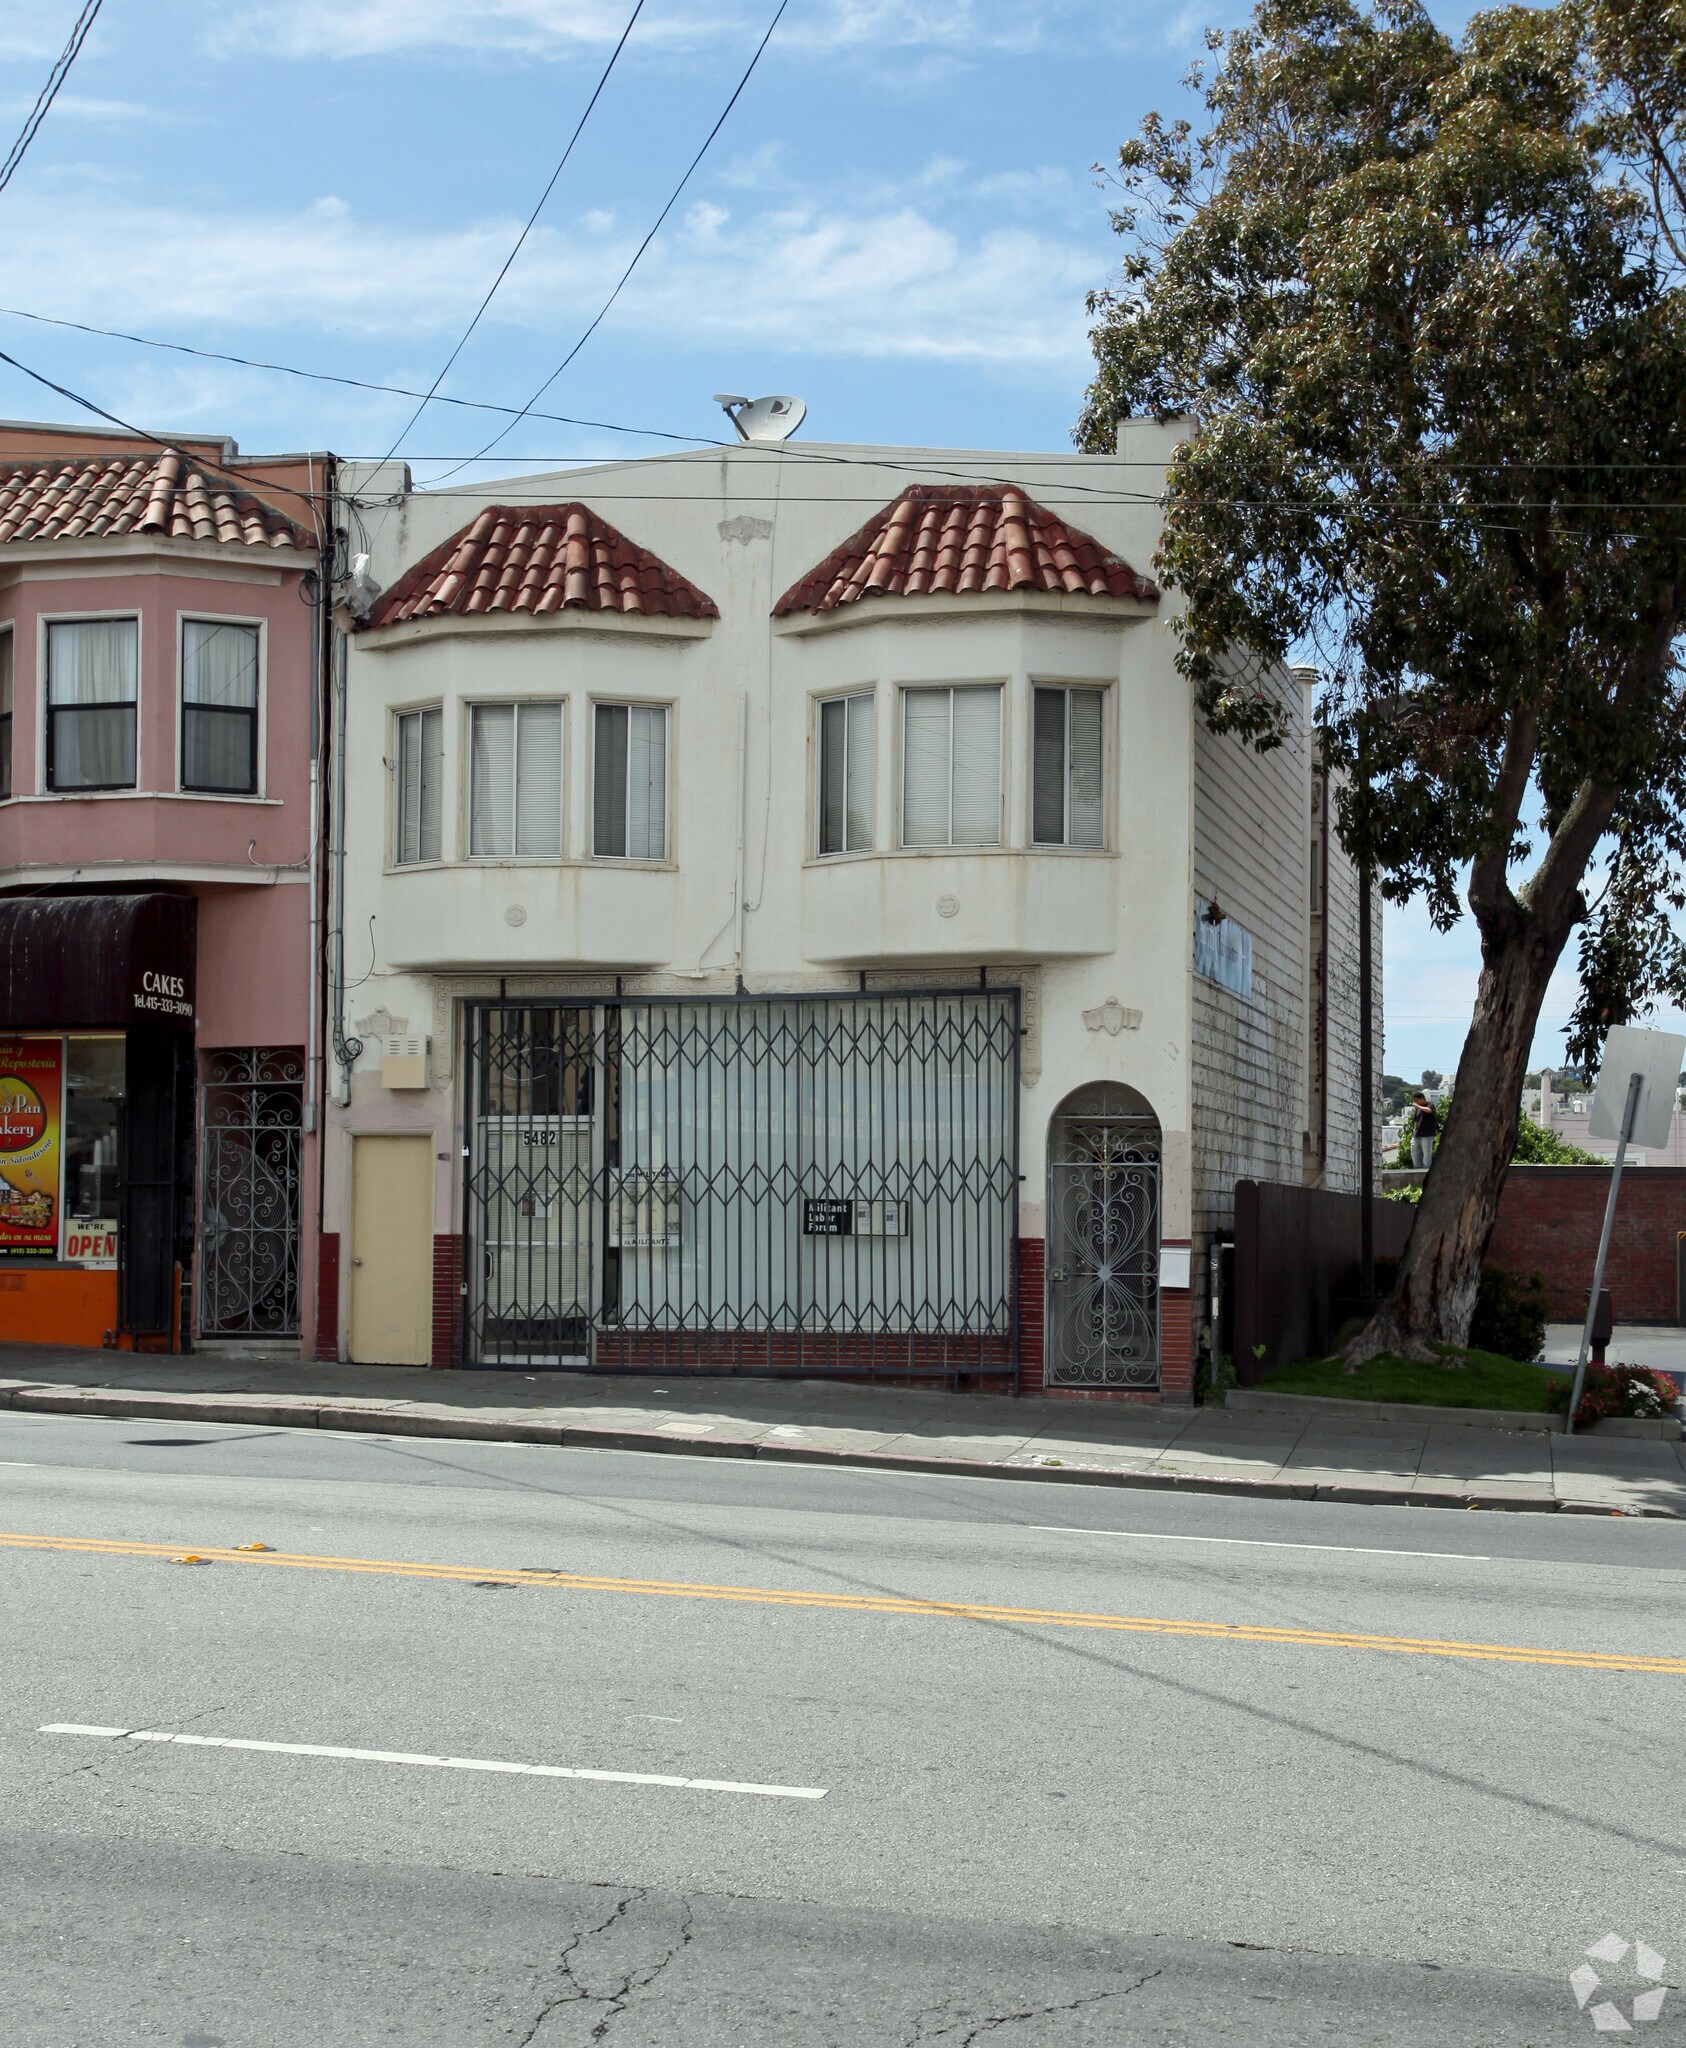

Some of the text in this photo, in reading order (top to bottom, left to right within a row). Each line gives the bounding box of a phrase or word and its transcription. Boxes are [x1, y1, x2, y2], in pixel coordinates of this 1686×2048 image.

[143, 971, 184, 998] CAKES
[16, 1094, 42, 1114] Pan
[523, 1130, 556, 1146] 5482
[808, 1203, 848, 1213] Miliant
[808, 1213, 836, 1222] Labr
[77, 1223, 105, 1231] WE'RE
[67, 1235, 116, 1258] OPEN
